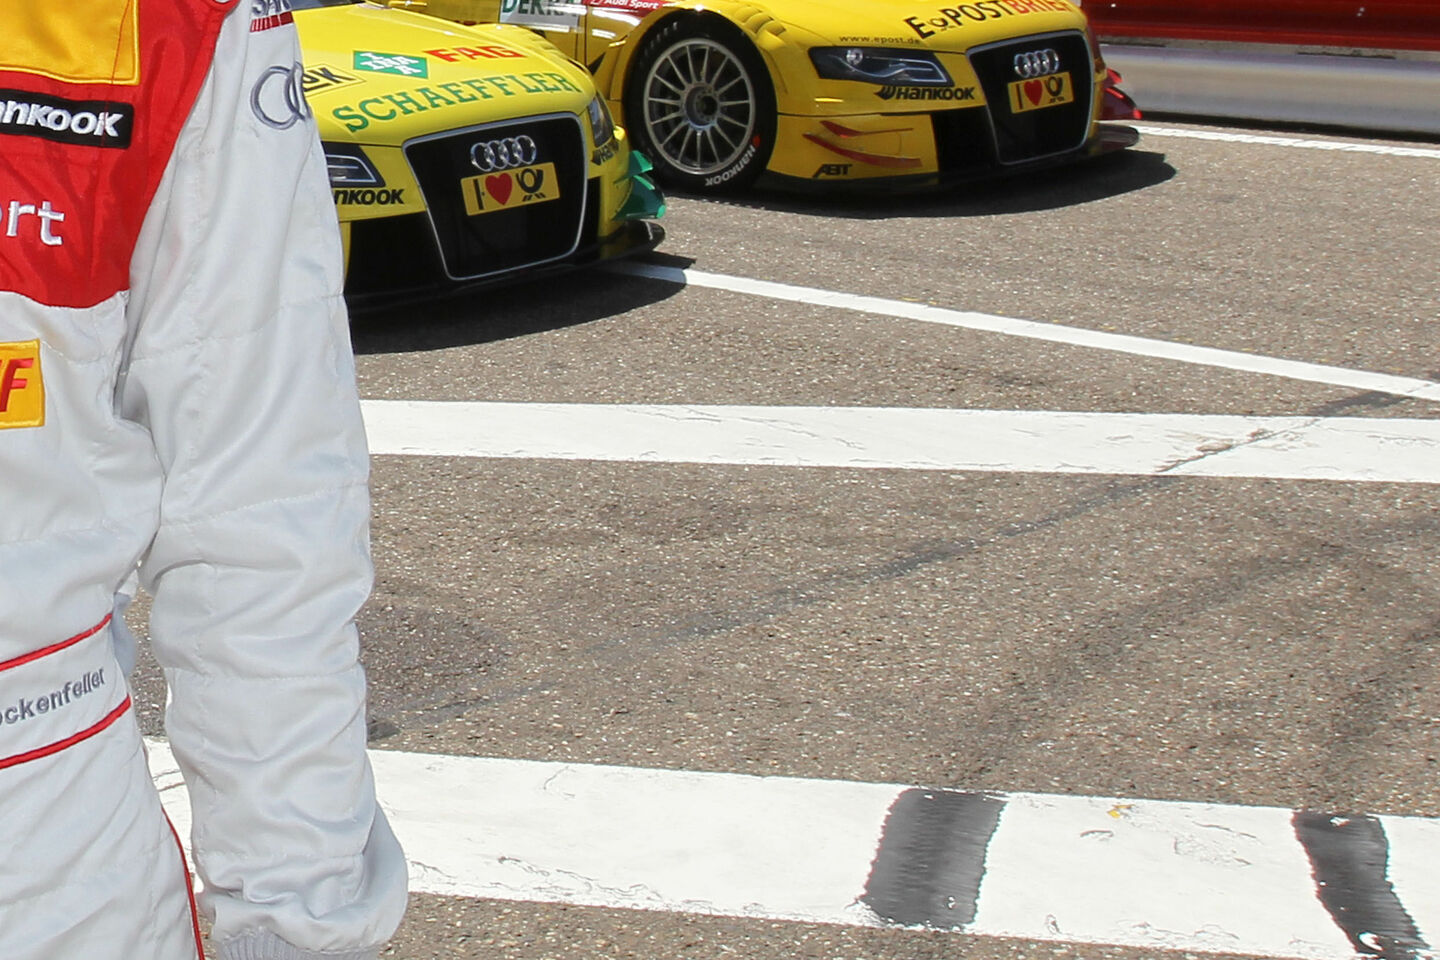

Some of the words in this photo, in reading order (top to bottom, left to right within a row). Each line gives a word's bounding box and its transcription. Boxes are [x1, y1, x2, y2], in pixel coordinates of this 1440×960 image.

[423, 45, 528, 63] FAG
[332, 71, 581, 133] SCHAEFFLER
[812, 163, 853, 179] ABT
